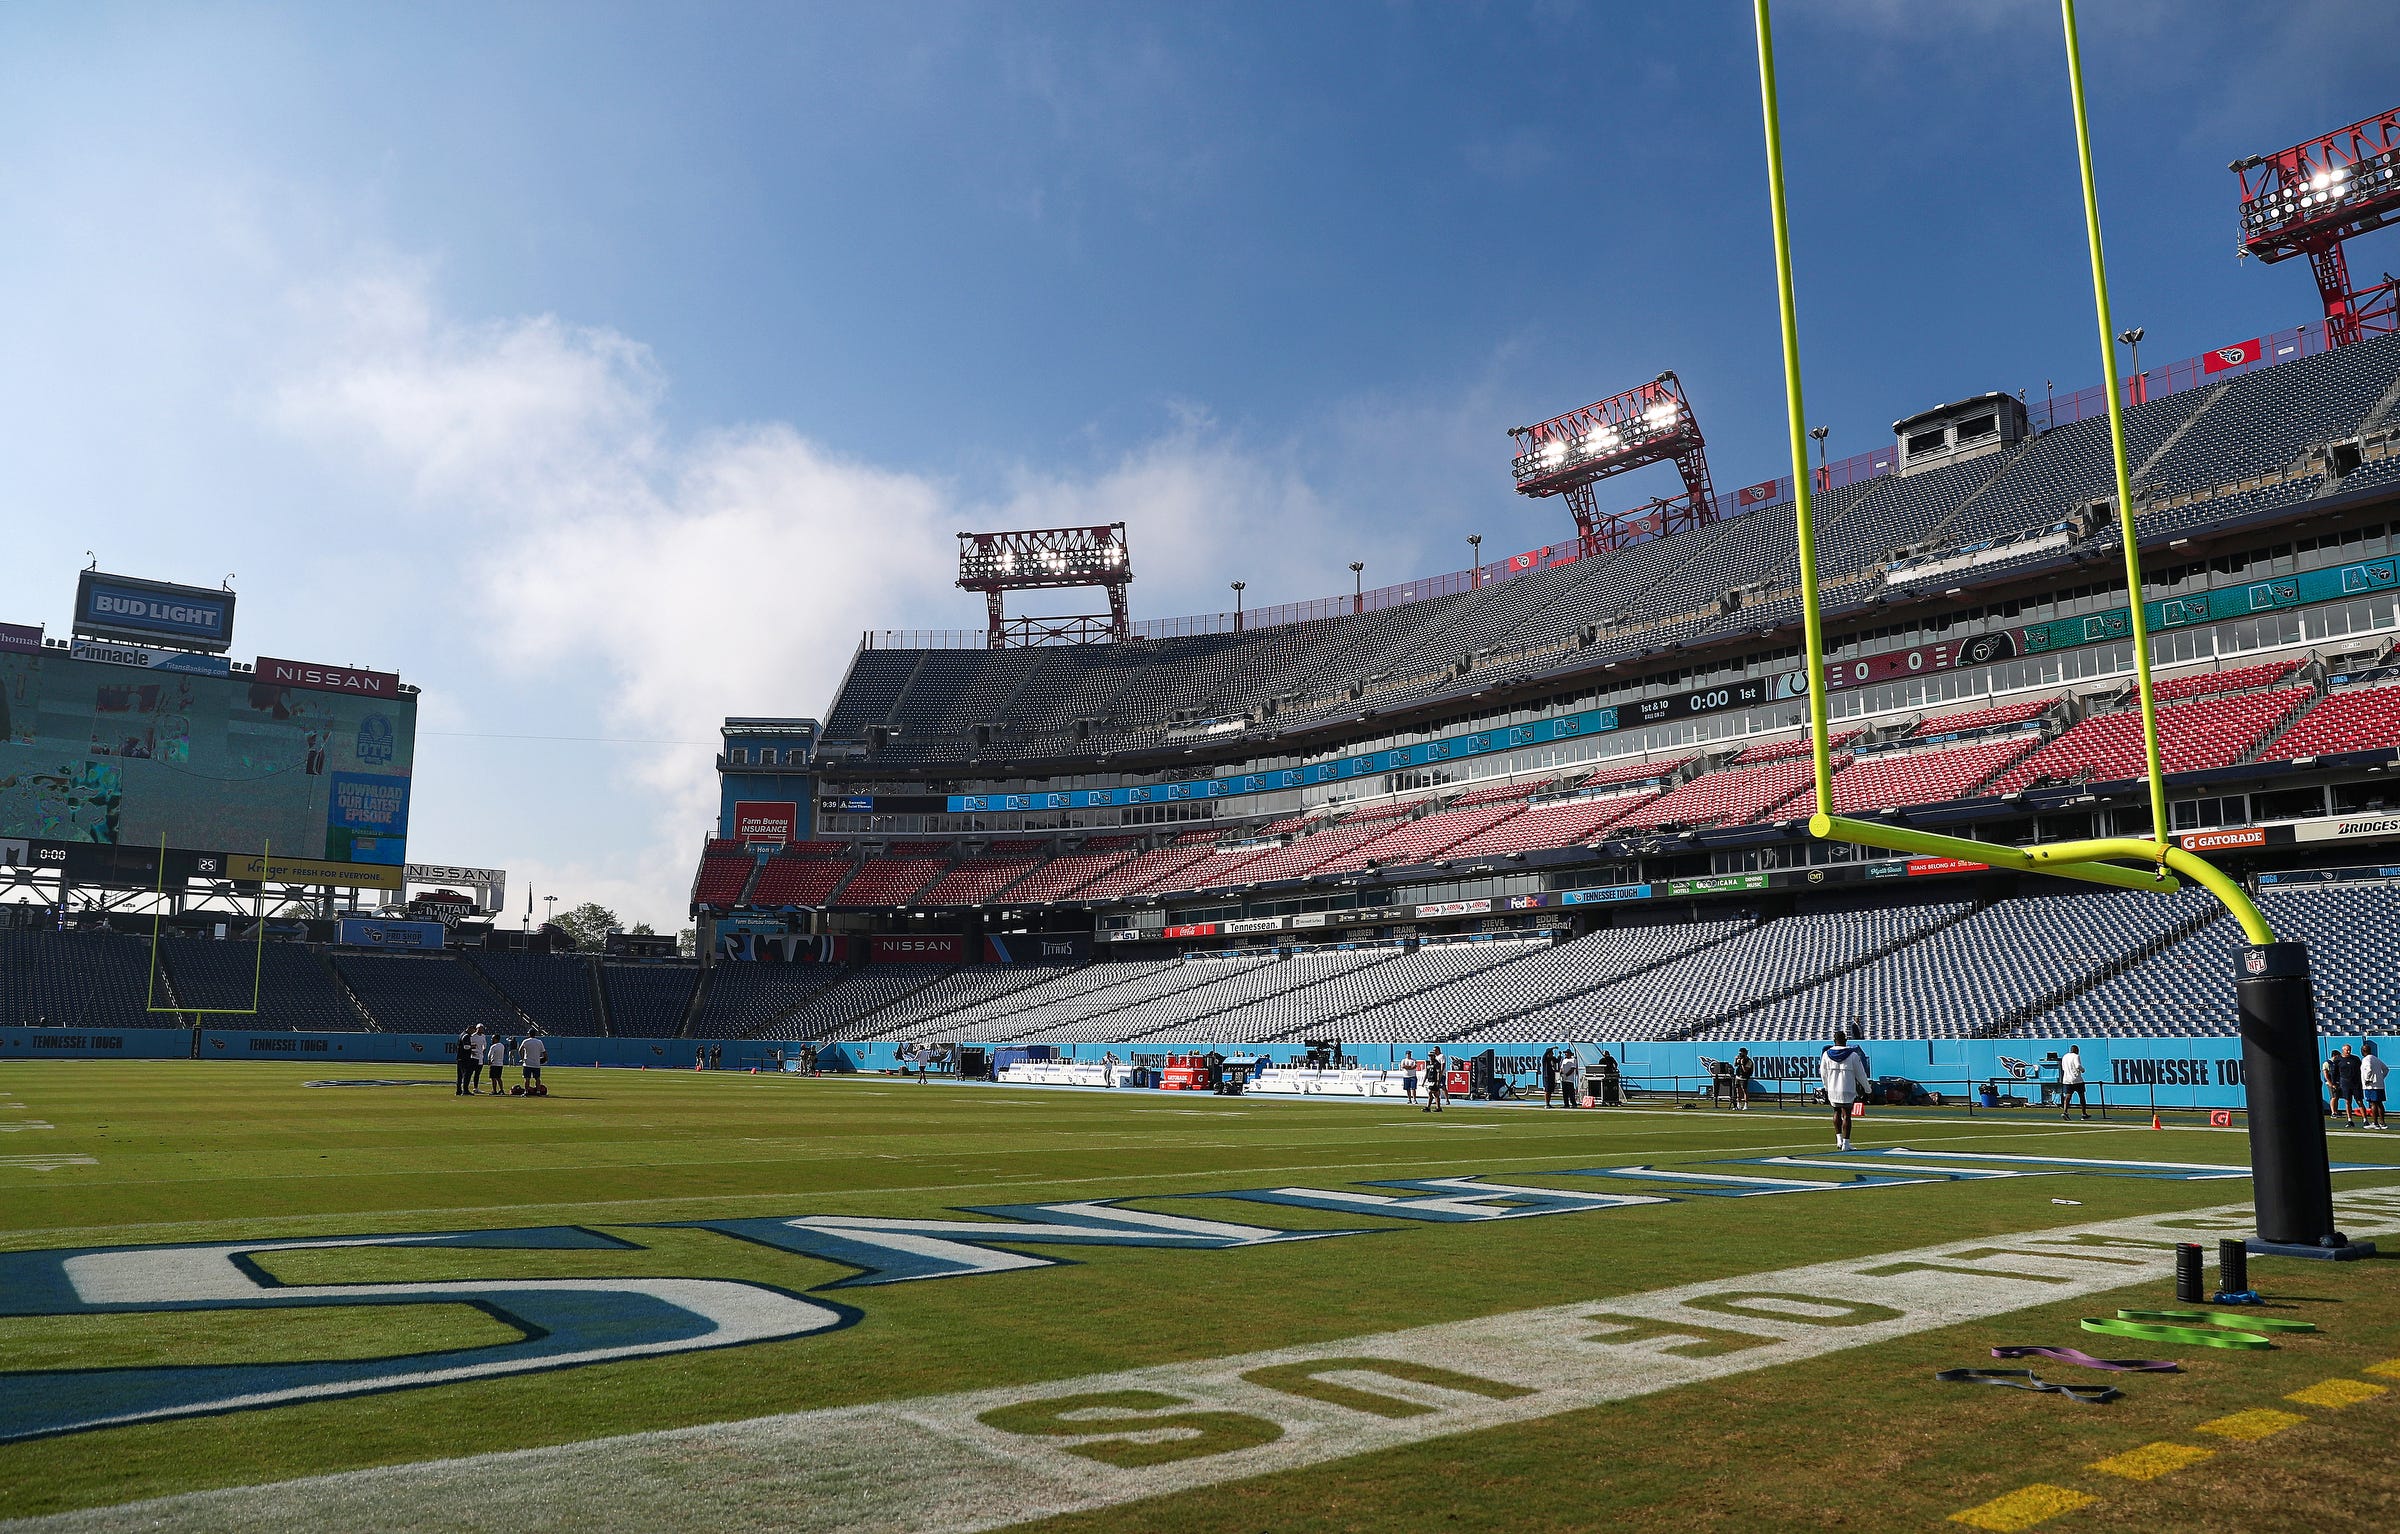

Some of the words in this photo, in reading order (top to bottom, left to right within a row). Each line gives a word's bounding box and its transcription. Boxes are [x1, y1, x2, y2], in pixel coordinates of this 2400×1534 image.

[96, 596, 147, 616] BUD
[150, 603, 217, 626] LIGHT
[72, 641, 149, 666] Pinnacle
[1908, 652, 1922, 670] 0
[166, 661, 228, 677] TitansBanking.com
[1855, 662, 1869, 680] 0
[275, 665, 381, 691] NISSAN
[1690, 690, 1729, 711] 0:00
[1740, 688, 1756, 700] 1st
[1641, 704, 1652, 713] 1st
[1652, 702, 1659, 711] &
[1659, 700, 1669, 709] 10
[338, 782, 403, 798] DOWNLOAD
[338, 795, 362, 809] OUR
[363, 796, 401, 813] LATEST
[345, 808, 393, 823] EPISODE
[2337, 820, 2400, 834] BRIDGES
[2198, 832, 2263, 847] GATORADE
[40, 849, 67, 861] 0:00
[200, 860, 215, 870] 25
[292, 868, 318, 877] FRESH
[320, 870, 337, 878] FOR
[409, 865, 491, 881] NISSAN
[1810, 872, 1823, 880] CMT
[1583, 889, 1617, 901] TENNESSEE
[1617, 888, 1638, 899] TOUGH
[434, 903, 471, 915] TITAN
[1511, 896, 1538, 909] FedEx
[1481, 918, 1505, 928] STEVE
[1536, 914, 1559, 924] EDDIE
[1230, 921, 1278, 932] Tennessean.
[1346, 928, 1374, 938] WARREN
[1393, 925, 1416, 933] FRANK
[386, 932, 401, 940] PRO
[402, 932, 422, 941] SHOP
[1277, 935, 1297, 943] BRUCE
[883, 941, 951, 951] NISSAN
[1041, 941, 1072, 956] TITANS
[2248, 959, 2265, 971] NFL
[32, 1035, 87, 1049] TENNESSEE
[90, 1035, 123, 1049] TOUGH
[250, 1038, 297, 1051] TENNESSEE
[300, 1038, 328, 1052] TOUGH
[1495, 1056, 1542, 1075] ENNESSEE
[1753, 1056, 1821, 1078] TENNESSEE
[2111, 1059, 2210, 1085] TENNESSEE
[2215, 1059, 2247, 1086] TOU
[2213, 1112, 2226, 1125] G
[1578, 1291, 1906, 1358] OF
[974, 1356, 1546, 1470] US
